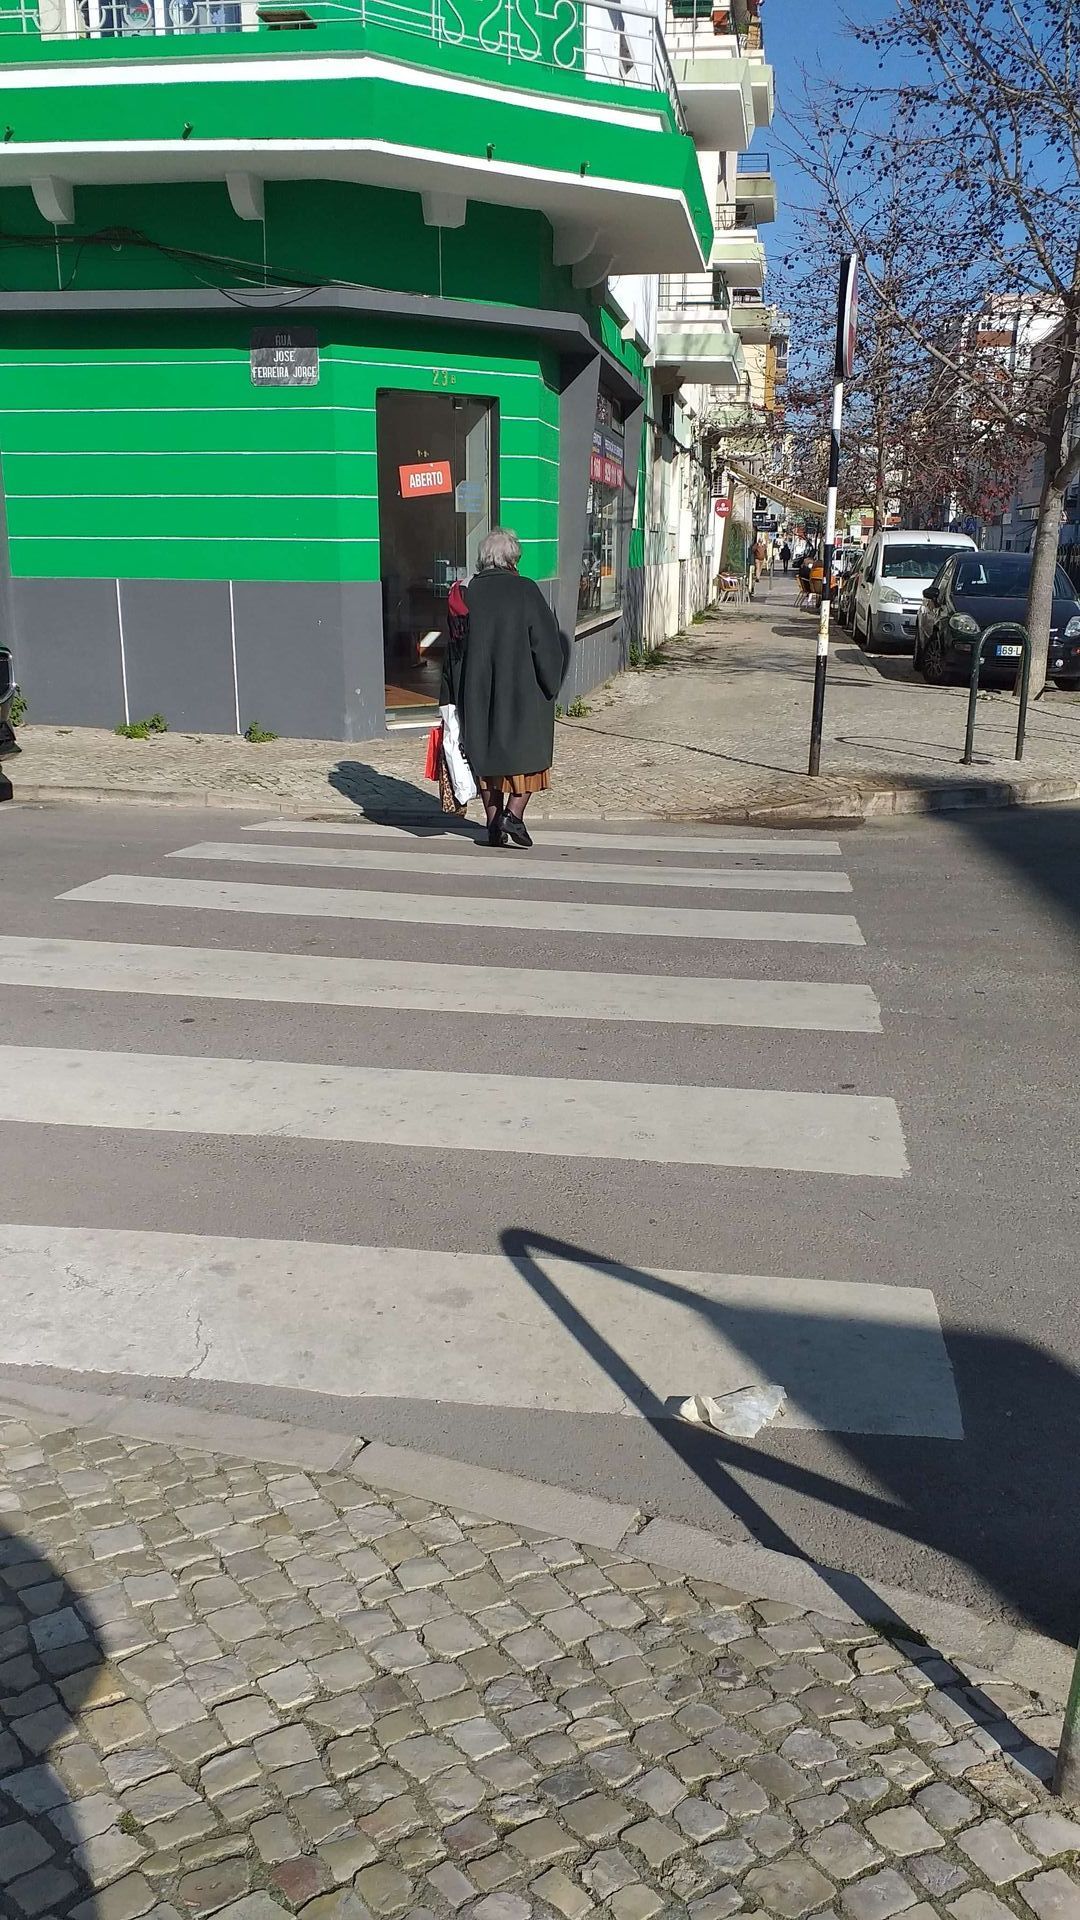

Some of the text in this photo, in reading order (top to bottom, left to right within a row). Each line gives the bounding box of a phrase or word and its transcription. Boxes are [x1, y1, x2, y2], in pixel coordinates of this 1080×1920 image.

[275, 334, 292, 346] RUA
[252, 365, 317, 378] FERREIRA JORGE
[409, 470, 443, 488] ABERTO
